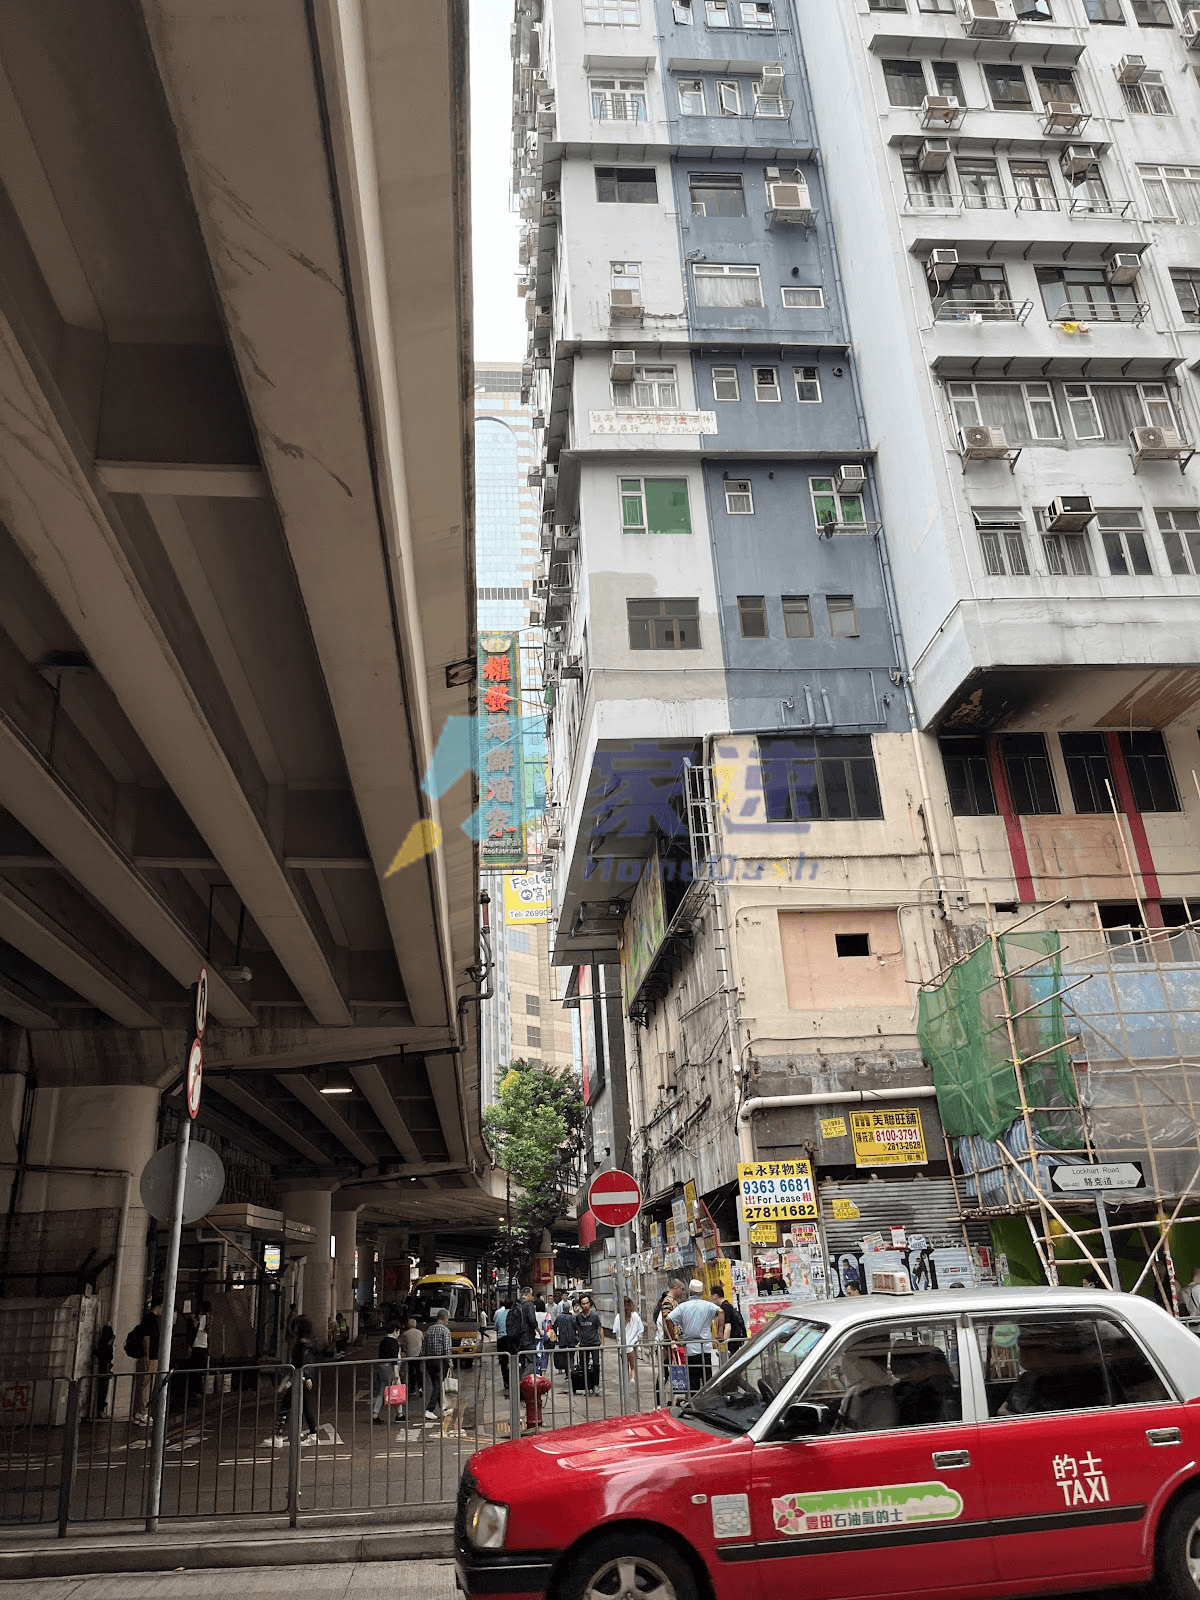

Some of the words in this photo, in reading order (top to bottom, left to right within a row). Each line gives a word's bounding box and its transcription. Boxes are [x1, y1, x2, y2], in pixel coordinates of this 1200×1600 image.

[511, 874, 541, 889] Feel
[876, 1128, 918, 1142] 8100-3791
[1071, 1167, 1100, 1175] Lockhart
[1102, 1166, 1120, 1174] Road
[743, 1180, 775, 1195] 9363
[779, 1178, 811, 1193] 6681
[1083, 1176, 1113, 1187] 駱克道
[745, 1195, 756, 1205] 出
[757, 1195, 772, 1204] For
[774, 1194, 801, 1203] Lease
[745, 1204, 816, 1219] 27811682
[1052, 1450, 1104, 1480] 的士
[1056, 1475, 1111, 1507] TAXI
